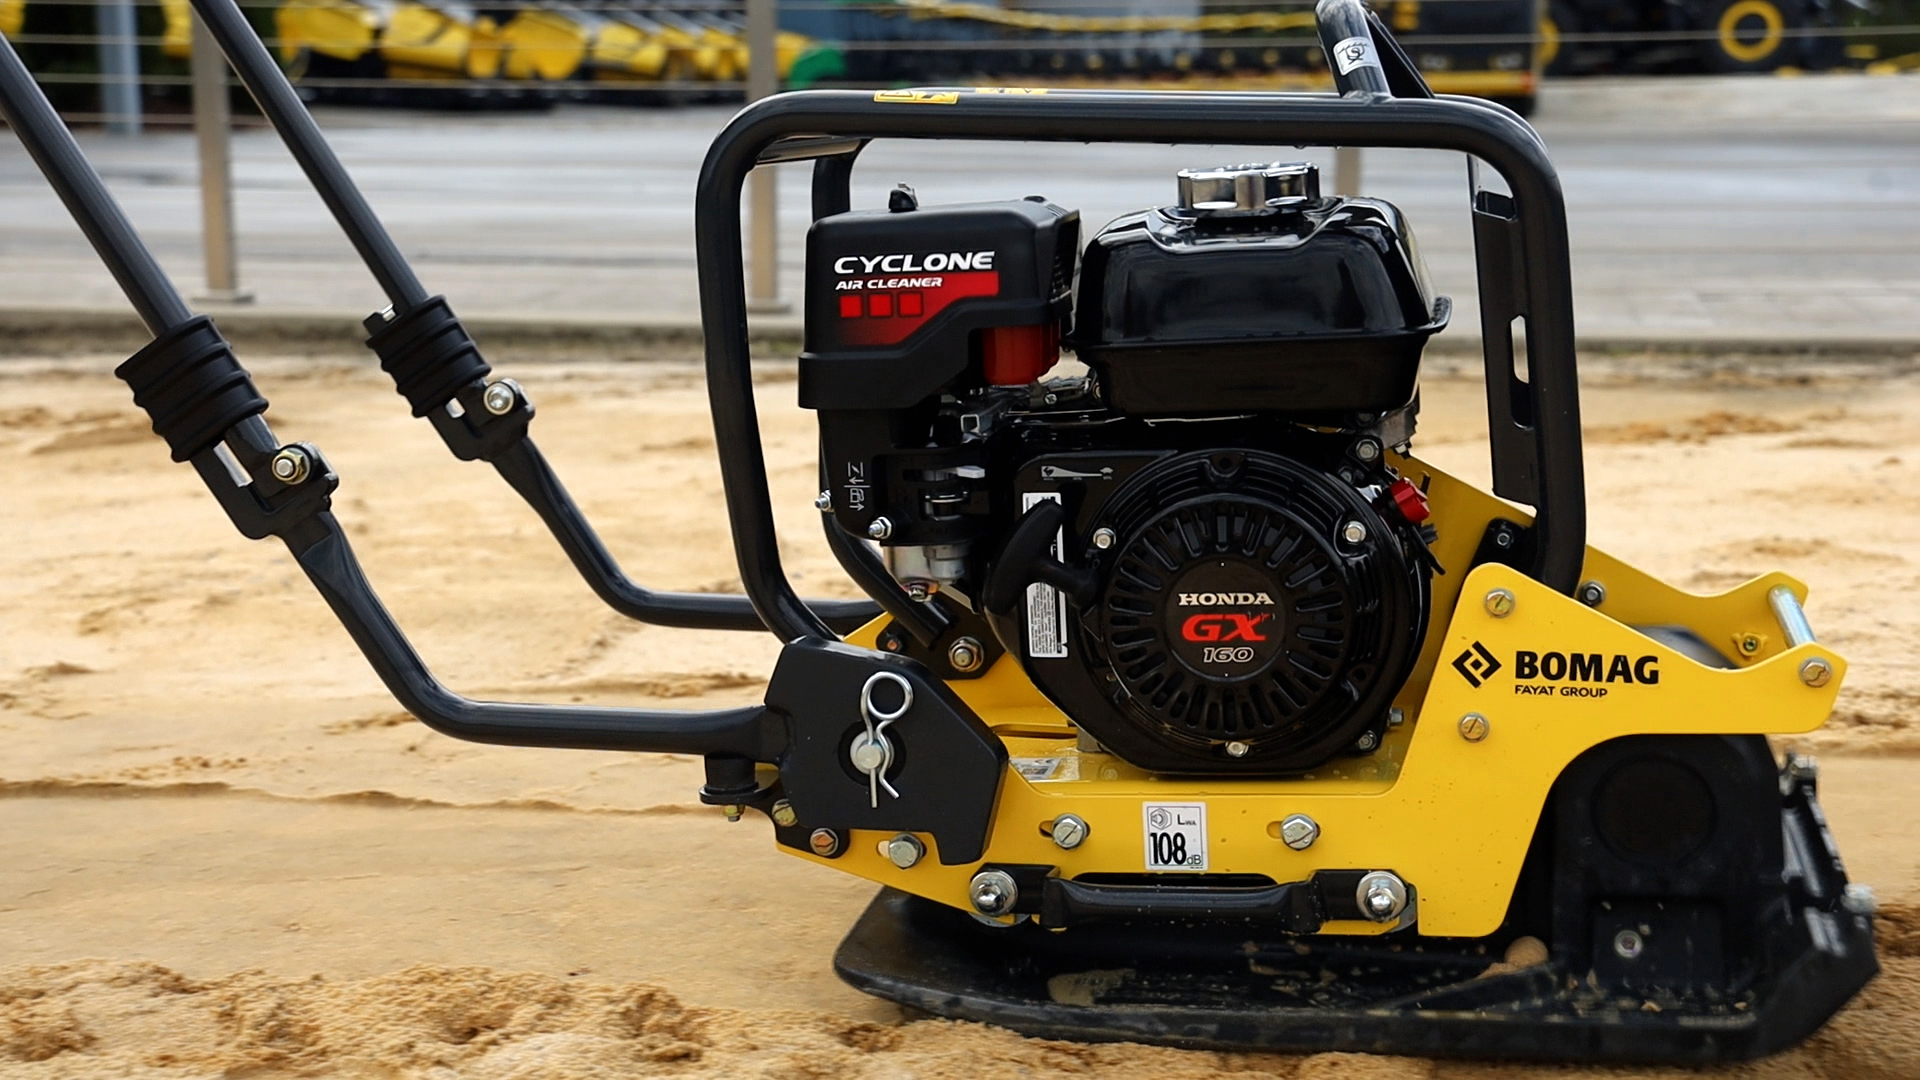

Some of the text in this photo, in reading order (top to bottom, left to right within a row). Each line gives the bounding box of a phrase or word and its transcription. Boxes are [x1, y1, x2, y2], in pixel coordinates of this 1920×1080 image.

[834, 251, 995, 274] CYCLONE
[835, 277, 942, 291] AIR CLEANER
[1178, 592, 1275, 606] HONDA
[1182, 613, 1270, 642] GX
[1203, 647, 1254, 663] 160
[1515, 651, 1659, 685] BOMAG
[1515, 685, 1608, 698] FAYAT GROUP
[1150, 832, 1201, 865] 108 dB
